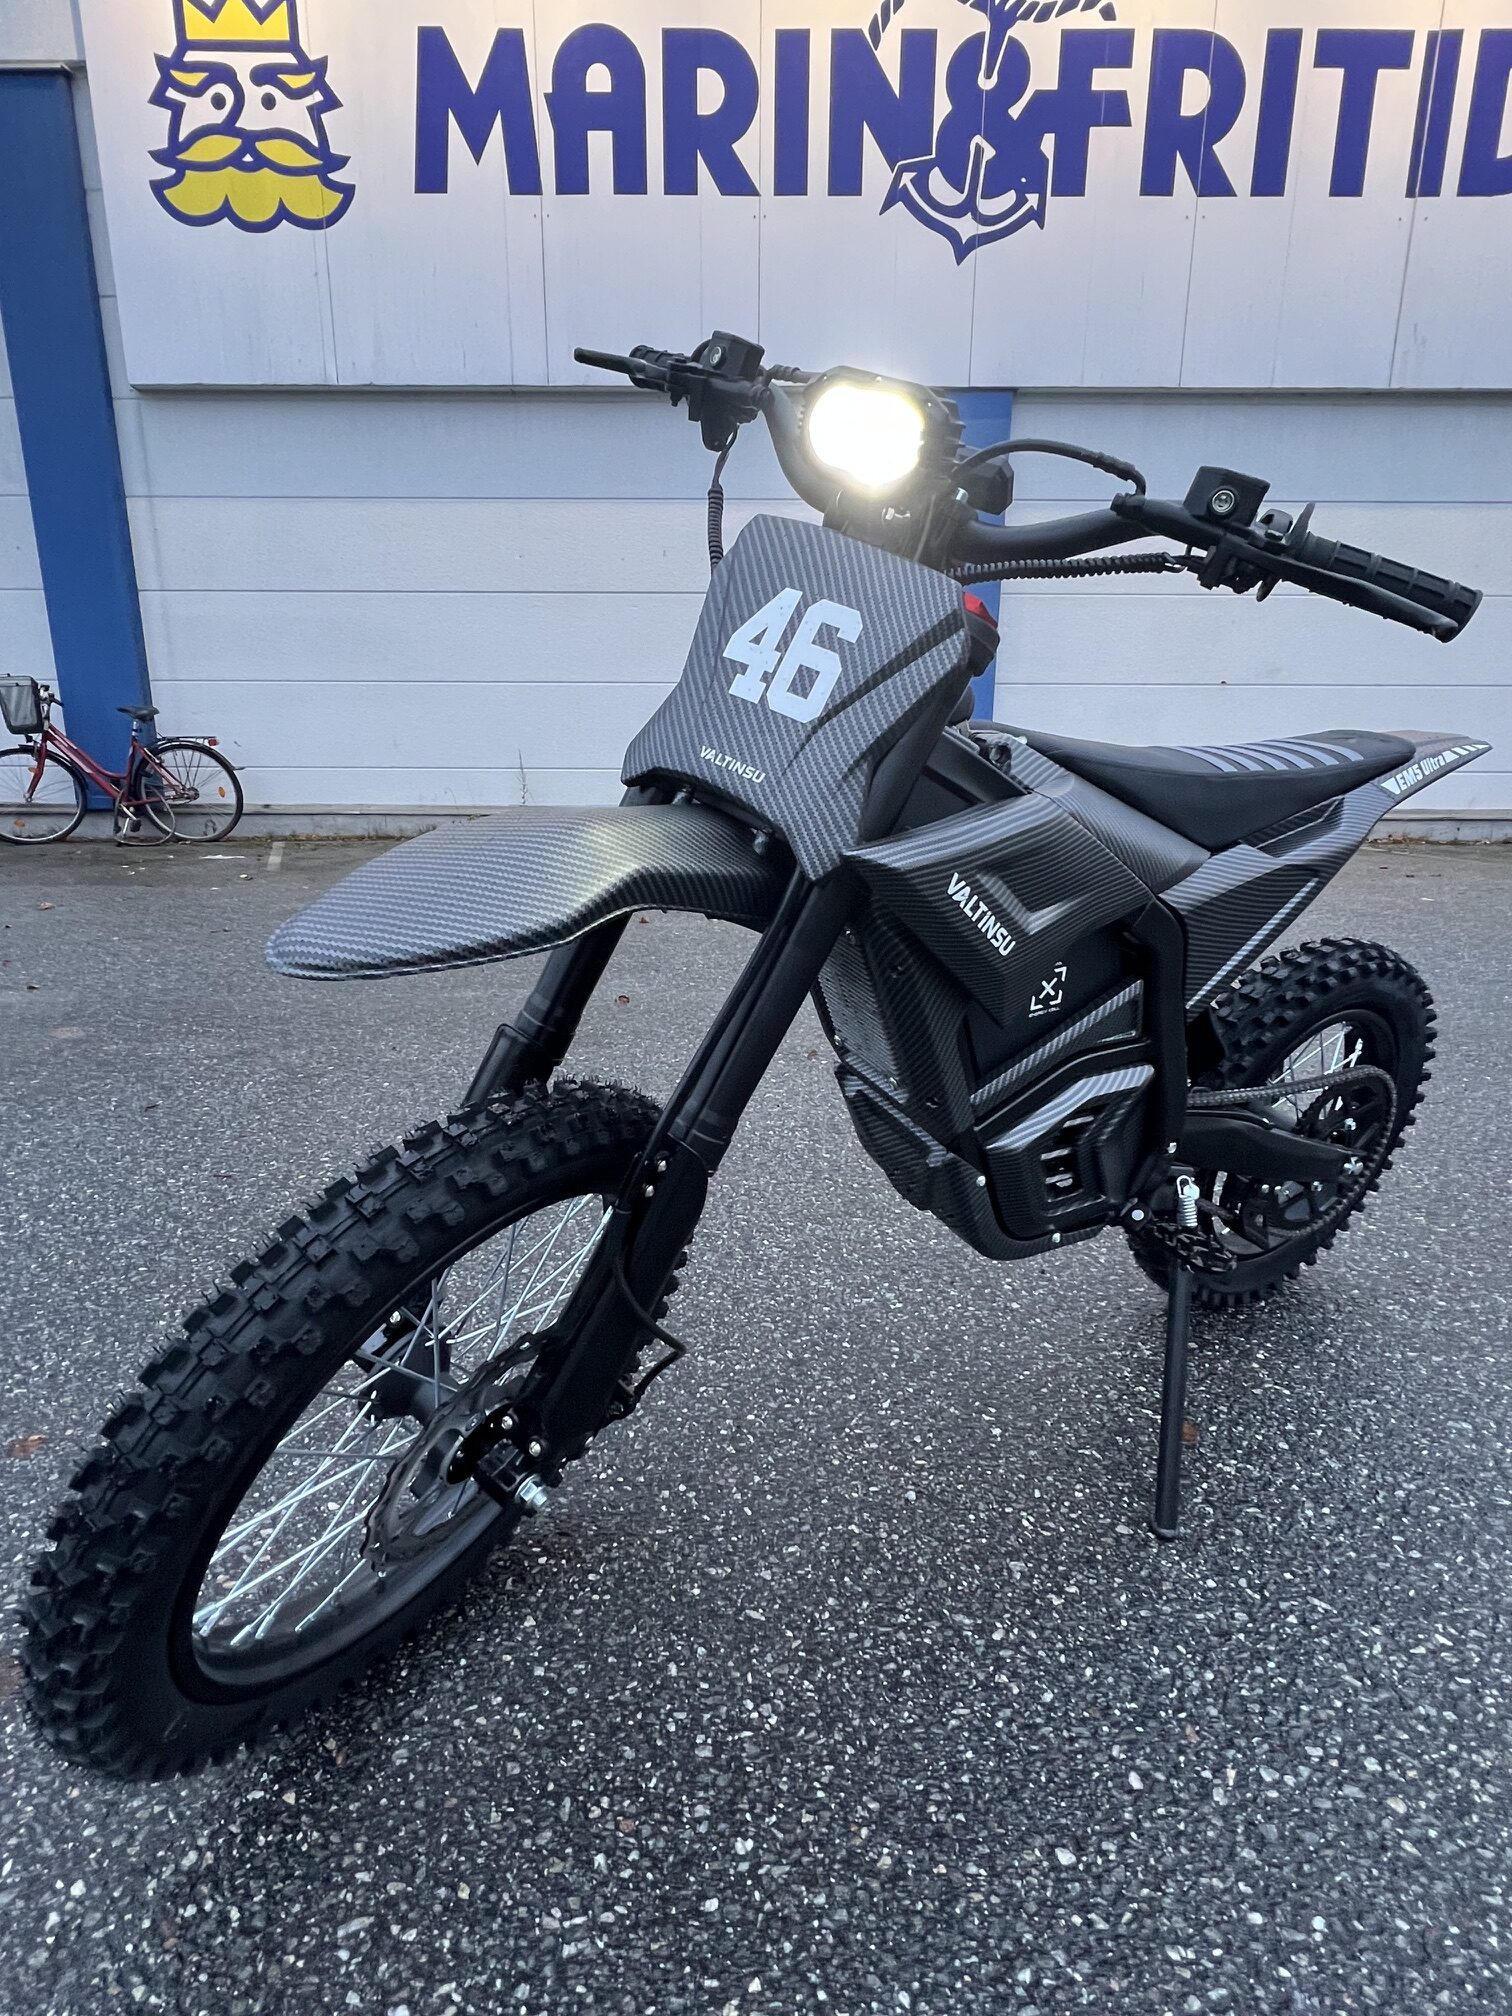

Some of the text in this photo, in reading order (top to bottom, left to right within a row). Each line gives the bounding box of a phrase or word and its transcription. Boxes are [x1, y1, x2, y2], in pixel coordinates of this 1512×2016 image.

[722, 587, 864, 724] 46
[700, 745, 767, 783] VALTINSU
[1420, 754, 1446, 776] Ultra
[946, 872, 1016, 957] VALTINSU
